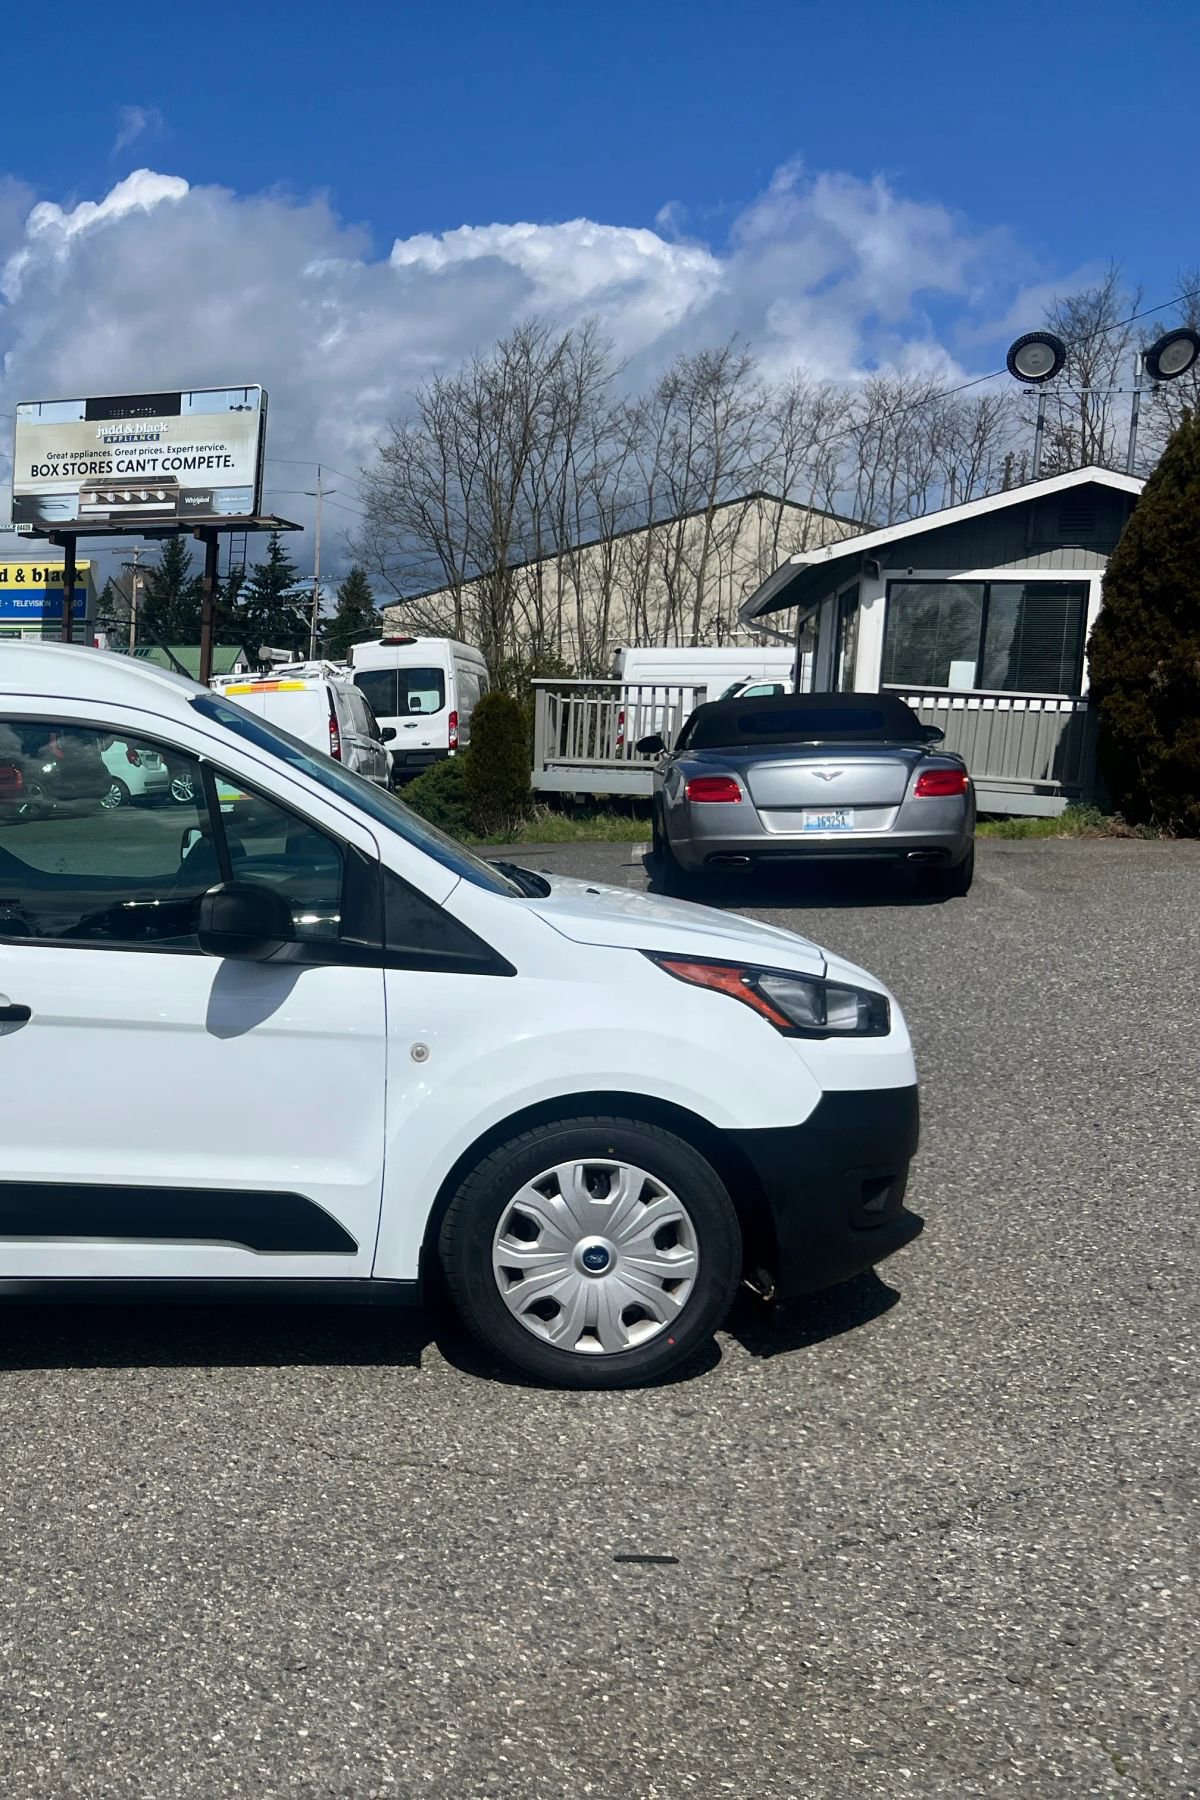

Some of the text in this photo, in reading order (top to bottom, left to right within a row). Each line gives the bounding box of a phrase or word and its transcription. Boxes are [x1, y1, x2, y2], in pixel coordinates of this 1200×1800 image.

[96, 421, 168, 439] judd & black
[107, 434, 157, 442] APPLIANCE
[47, 443, 227, 460] Great appliances. Great prices. Expert service.
[31, 454, 235, 478] BOX STORES CAN'T COMPETE.
[15, 568, 26, 583] &
